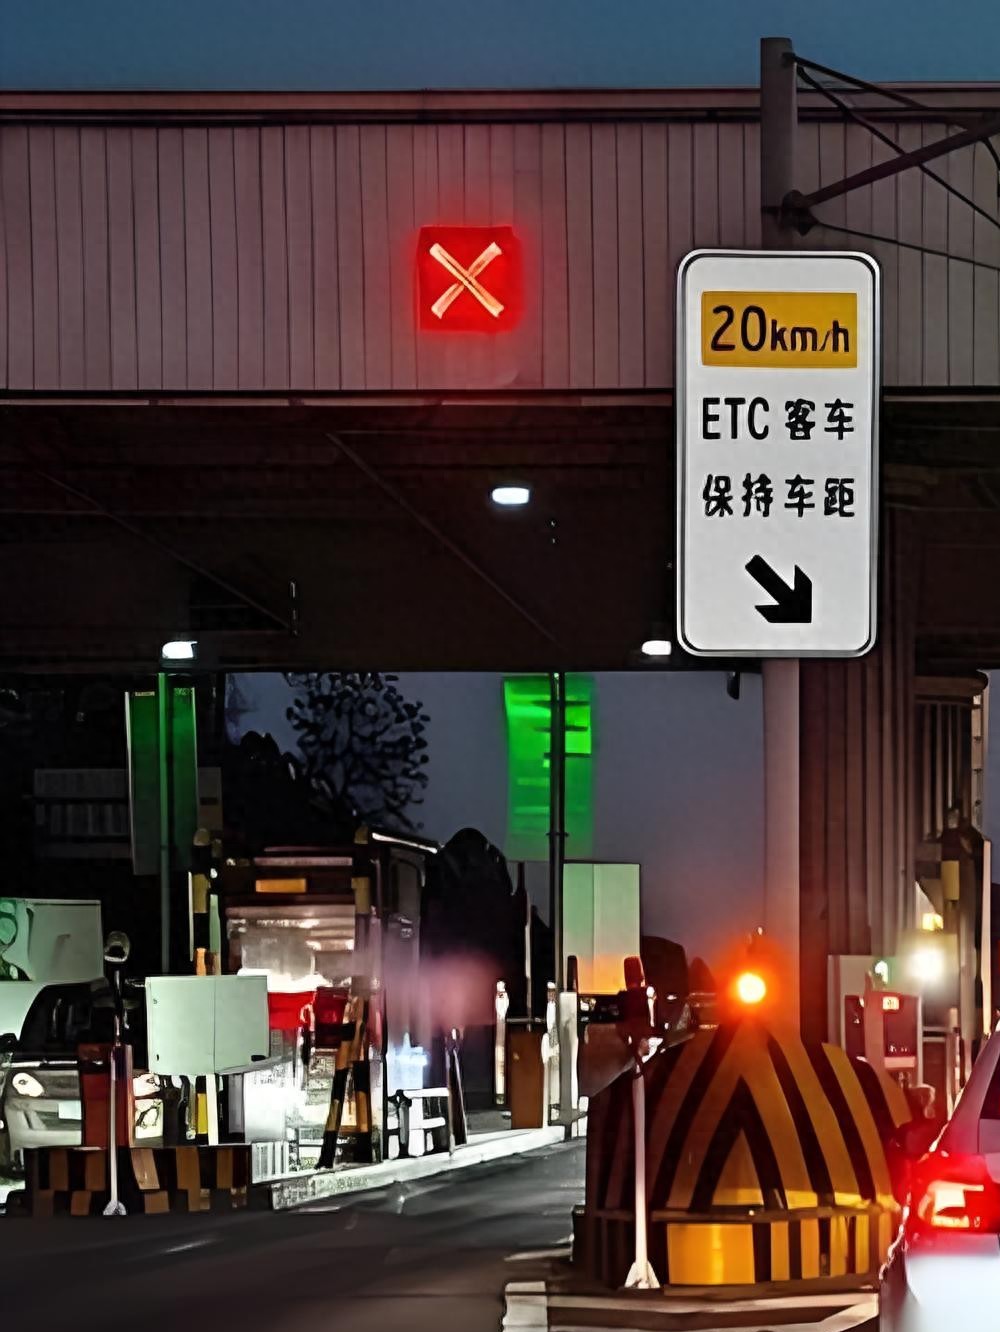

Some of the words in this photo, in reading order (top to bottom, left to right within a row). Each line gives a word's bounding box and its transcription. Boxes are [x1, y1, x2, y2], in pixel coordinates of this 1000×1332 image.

[710, 305, 850, 353] 20km/h
[702, 397, 770, 440] ETC
[784, 398, 855, 440] 客车
[702, 472, 855, 518] 保持车距
